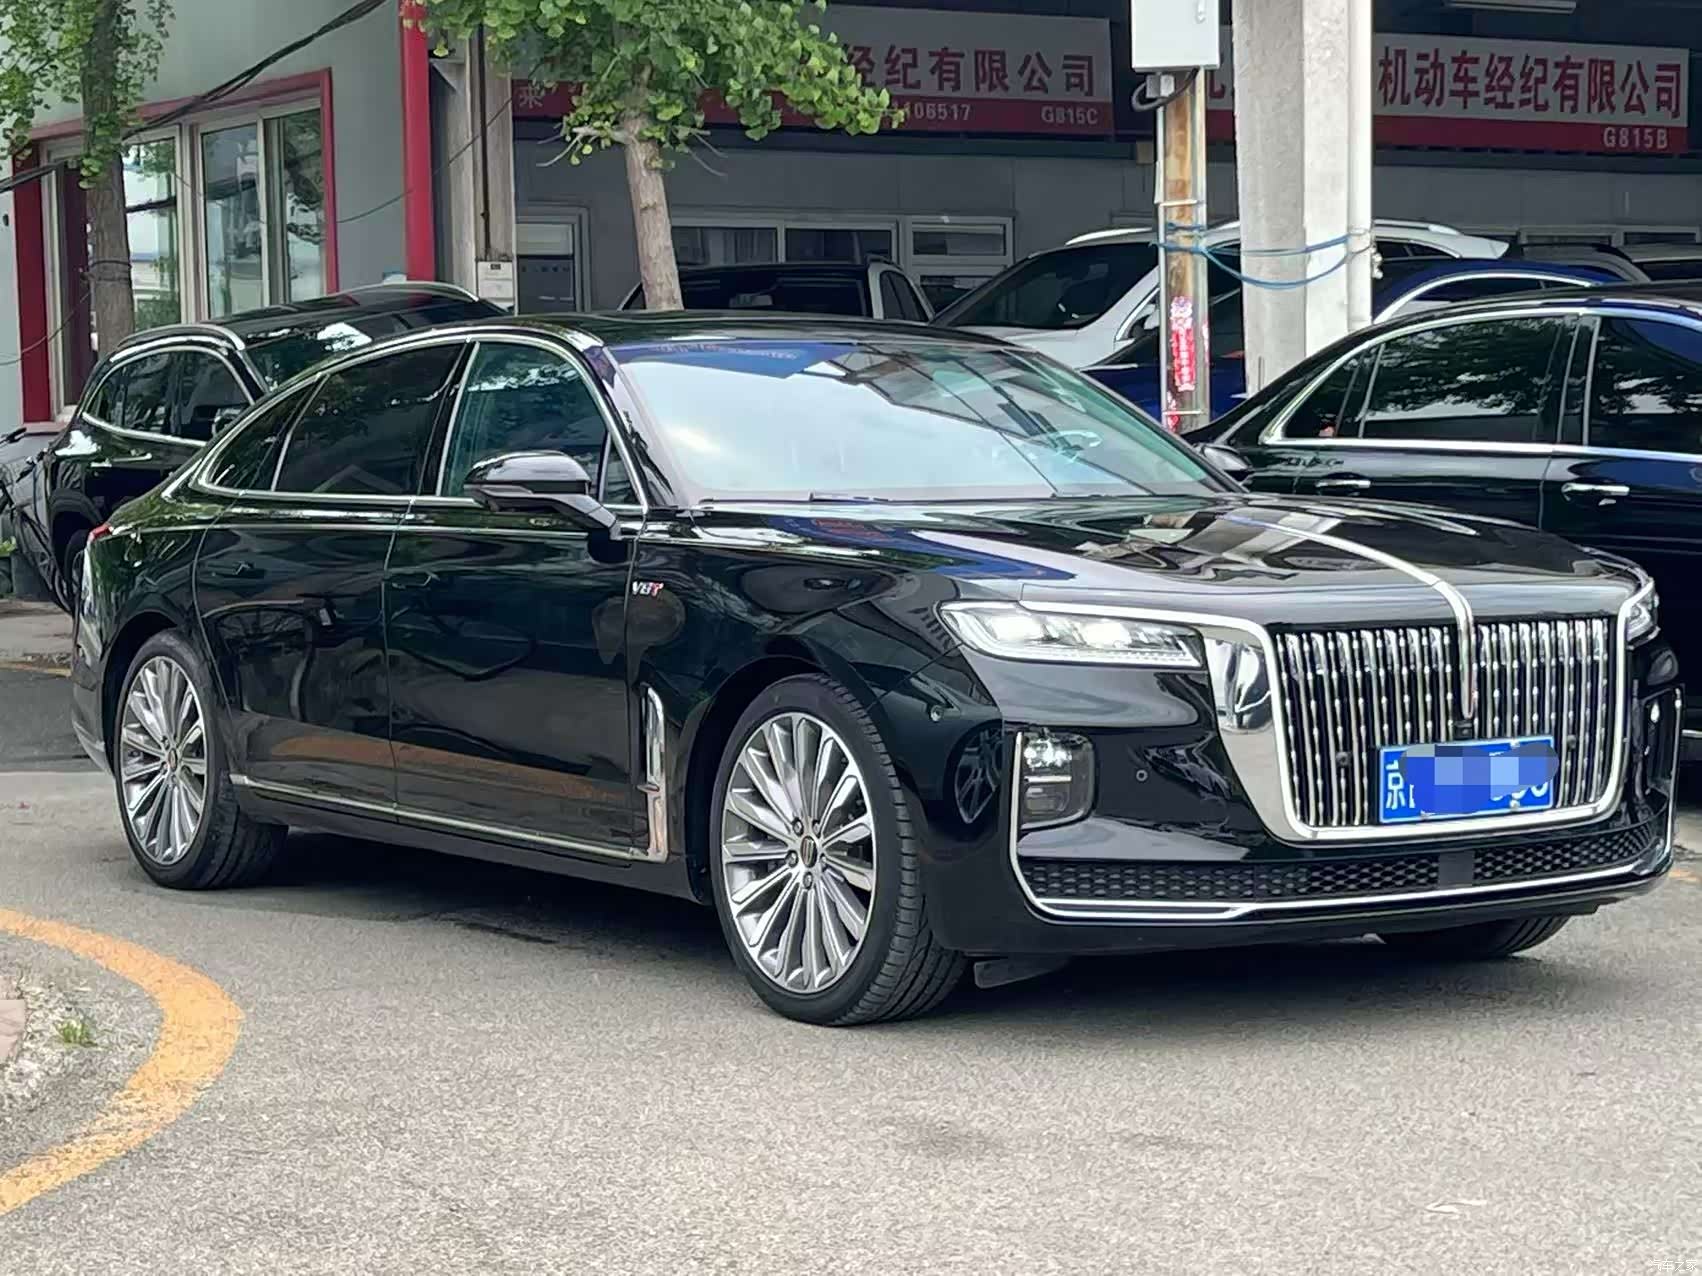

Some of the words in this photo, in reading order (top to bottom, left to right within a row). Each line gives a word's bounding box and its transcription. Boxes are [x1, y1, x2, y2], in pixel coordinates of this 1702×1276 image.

[1378, 46, 1682, 119] 机动车经纪有限公司
[1040, 105, 1098, 126] G815C
[1603, 126, 1669, 150] G815B
